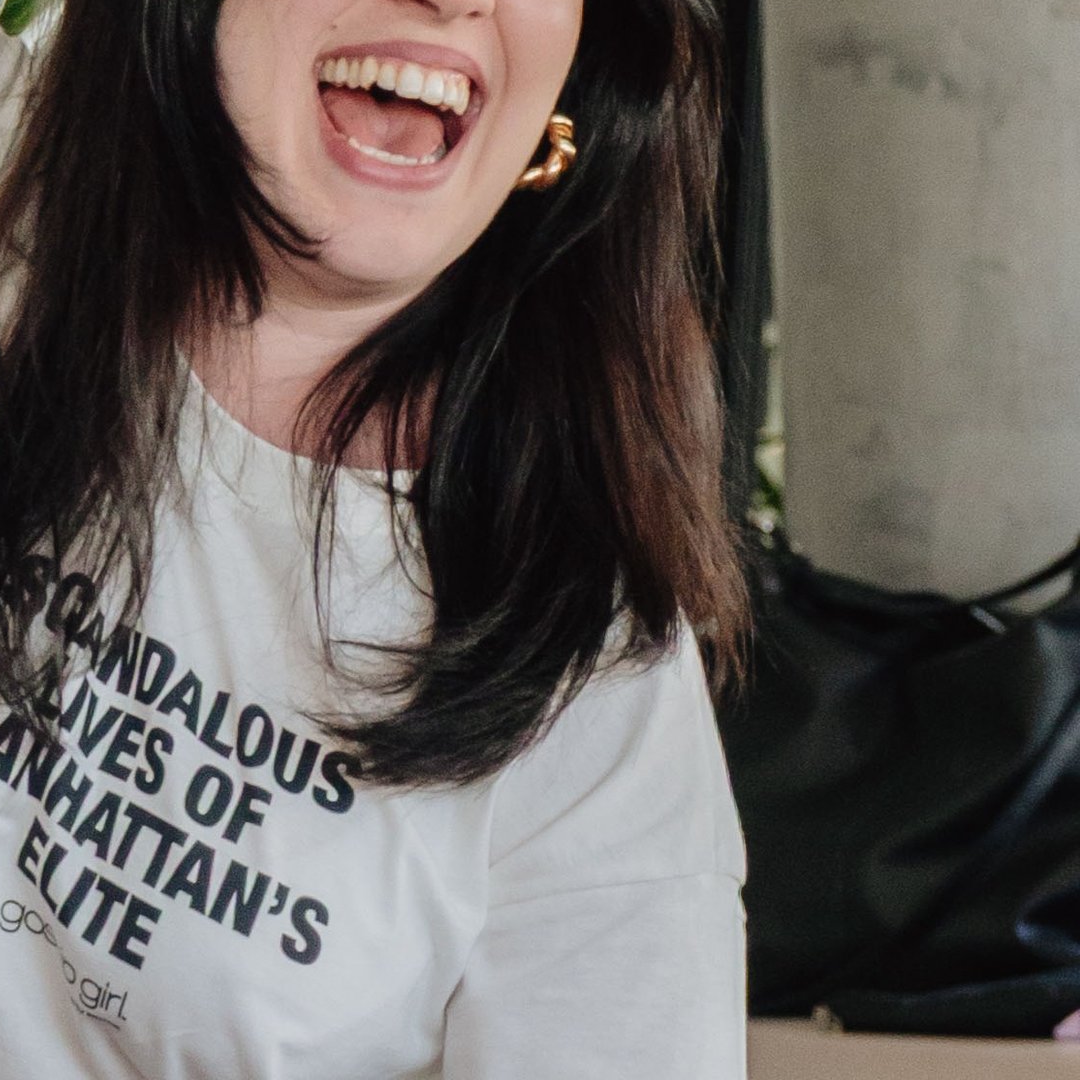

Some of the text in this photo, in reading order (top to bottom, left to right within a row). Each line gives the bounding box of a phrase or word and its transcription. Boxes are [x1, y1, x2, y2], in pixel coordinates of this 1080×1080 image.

[32, 654, 273, 845] LIVES OF
[18, 816, 162, 970] ELITE
